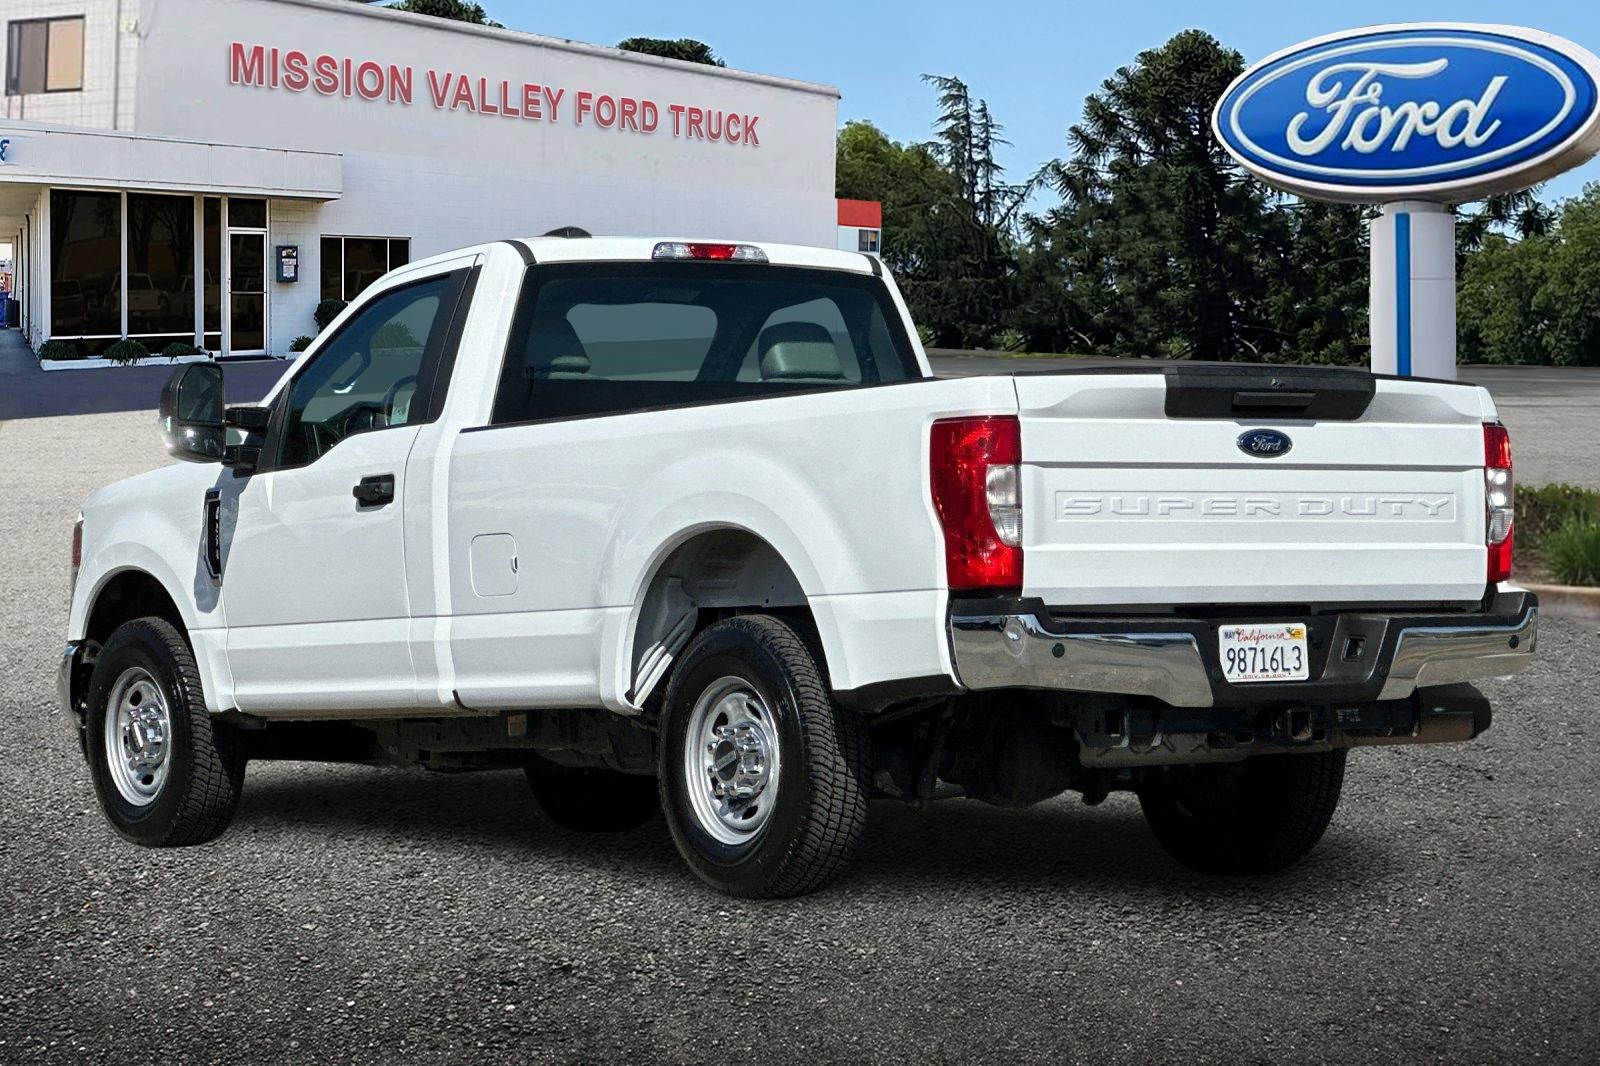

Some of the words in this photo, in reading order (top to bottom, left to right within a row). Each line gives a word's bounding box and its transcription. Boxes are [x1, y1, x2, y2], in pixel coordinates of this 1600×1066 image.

[229, 41, 413, 105] MISSION
[426, 69, 565, 122] VALLEY
[576, 90, 659, 134] FORD
[668, 103, 761, 147] TRUCK
[1286, 57, 1509, 157] Ford
[1251, 434, 1282, 452] Ford
[1063, 496, 1282, 516] SUPER
[1298, 496, 1450, 516] DUTY
[1236, 628, 1286, 645] California
[1226, 645, 1302, 675] 98716L3
